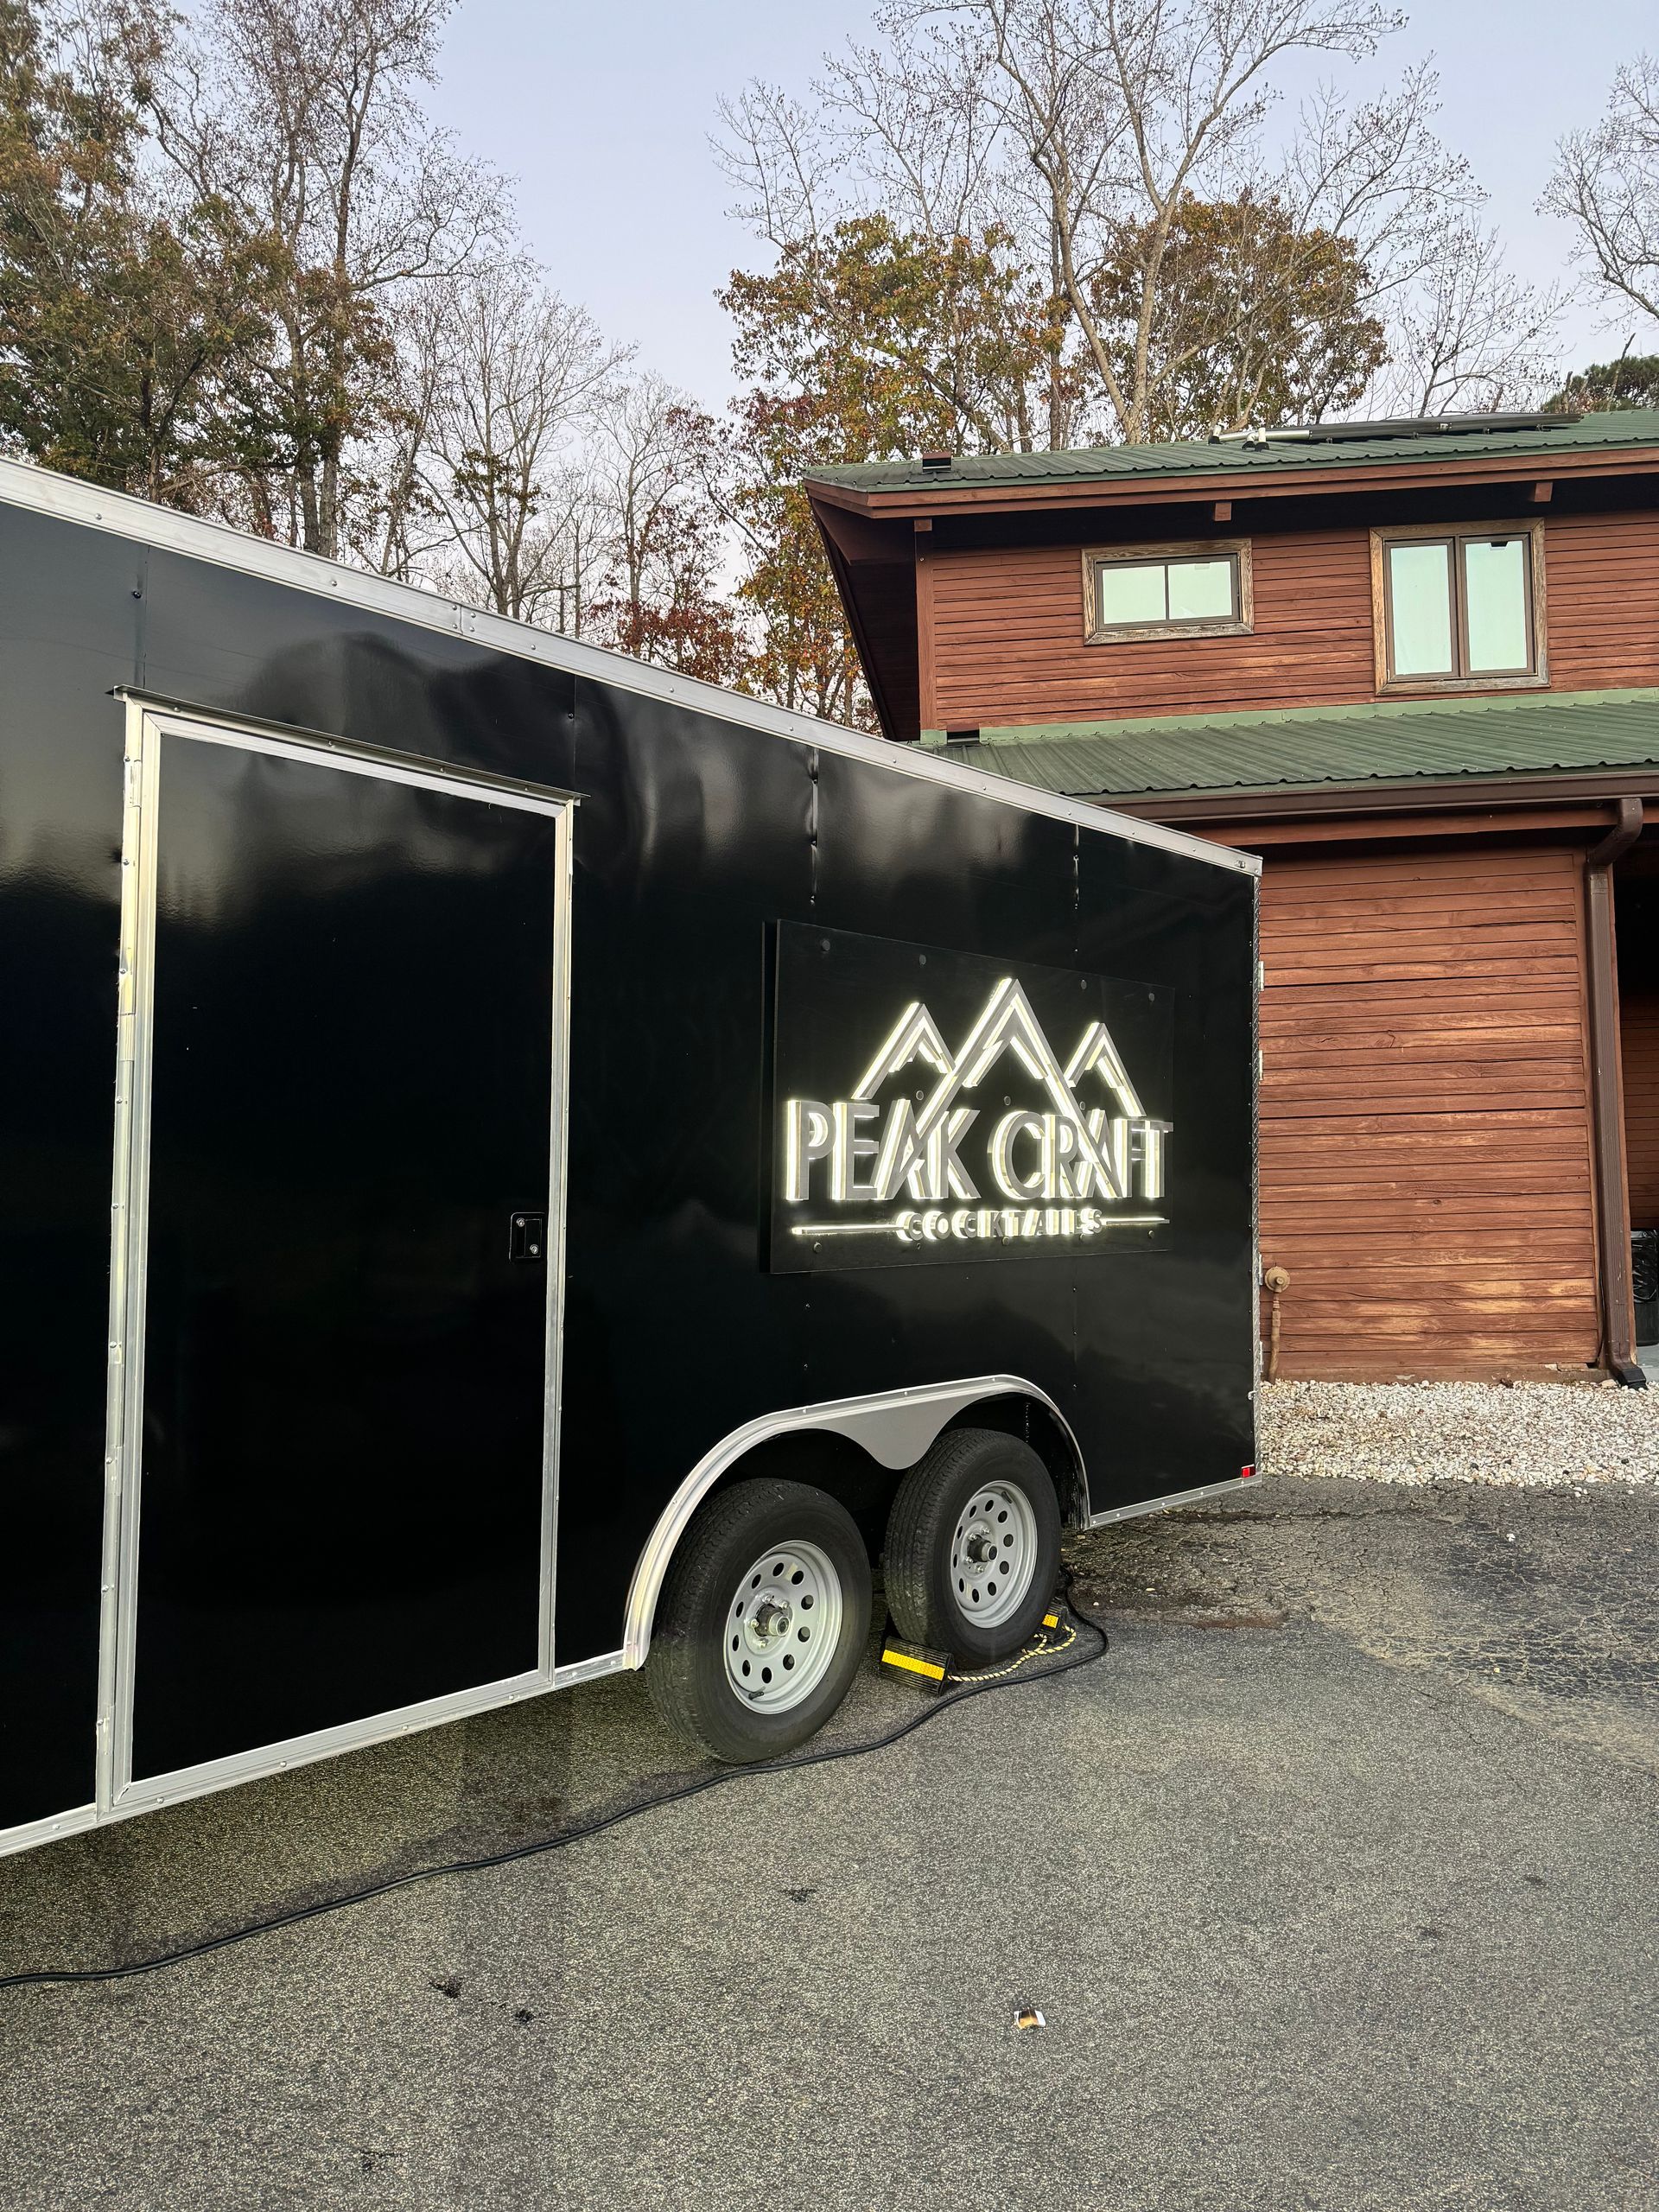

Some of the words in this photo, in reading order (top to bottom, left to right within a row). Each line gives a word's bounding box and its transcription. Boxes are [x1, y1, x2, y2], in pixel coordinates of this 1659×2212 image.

[785, 1098, 982, 1201] PEAK
[987, 1108, 1174, 1200] CRAFT
[896, 1208, 1103, 1241] COCKTAILS
